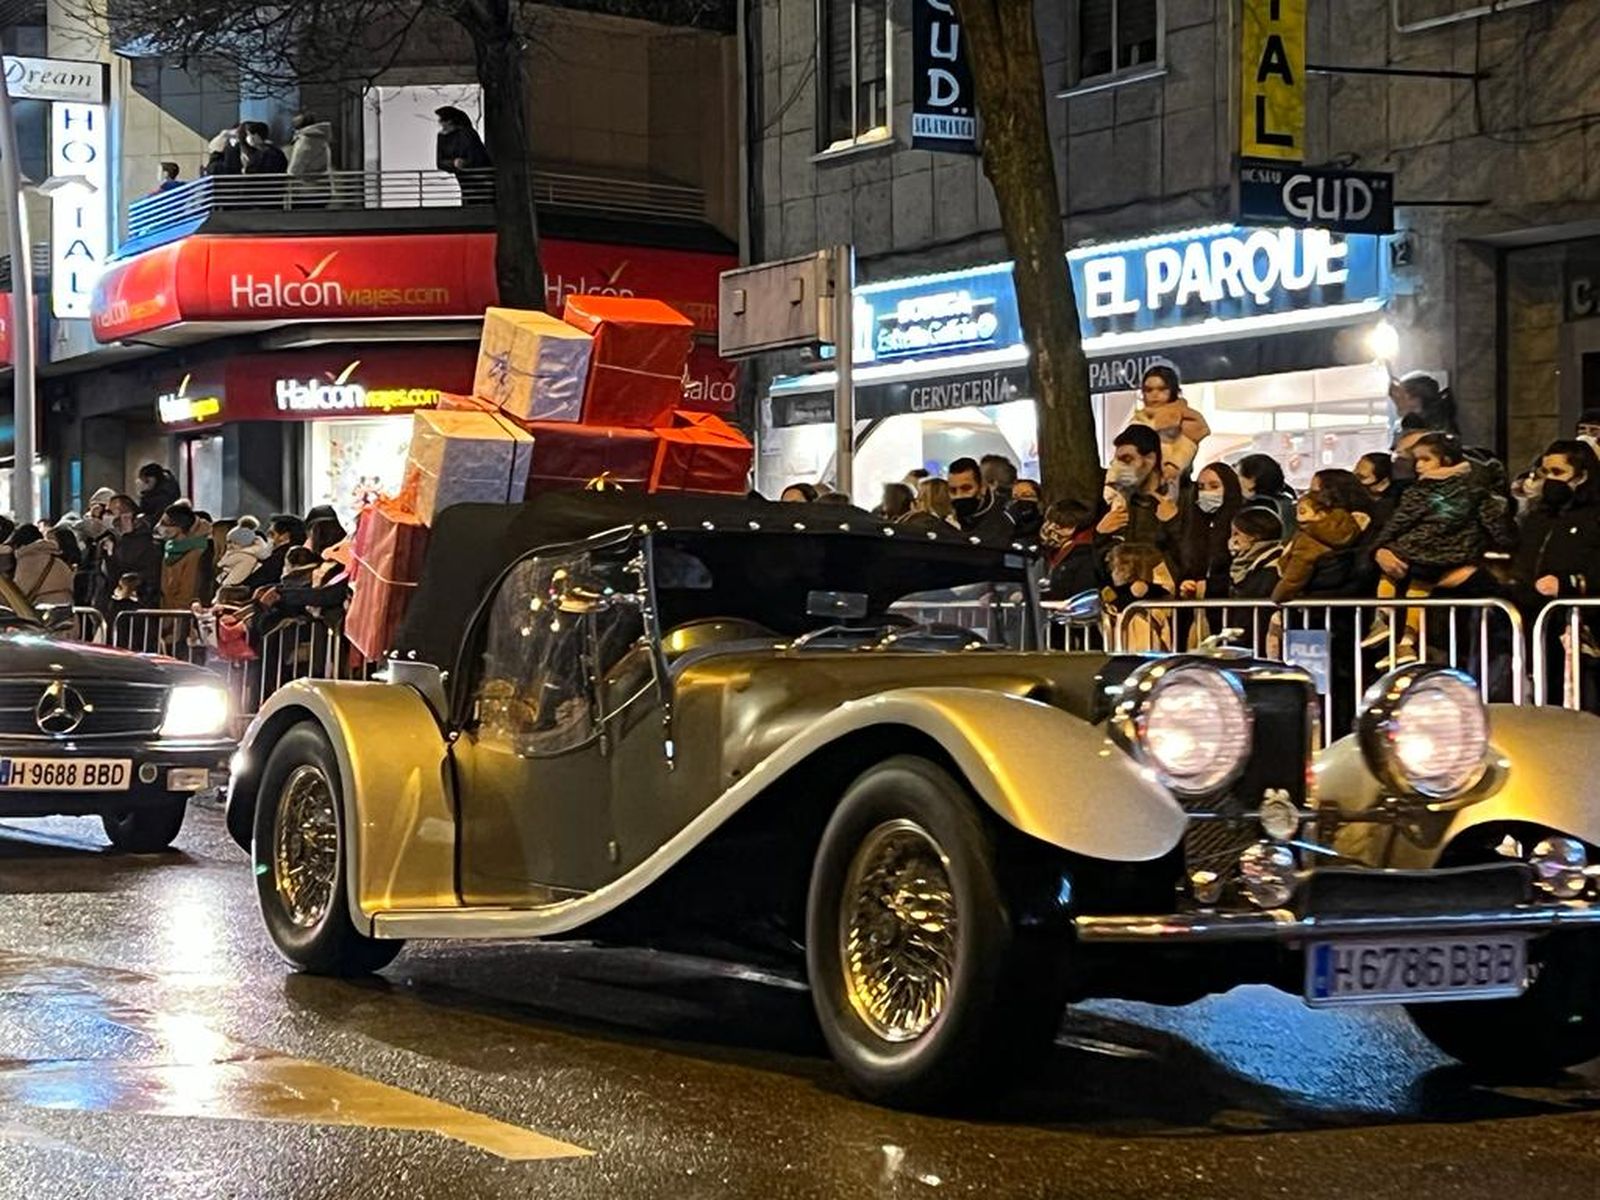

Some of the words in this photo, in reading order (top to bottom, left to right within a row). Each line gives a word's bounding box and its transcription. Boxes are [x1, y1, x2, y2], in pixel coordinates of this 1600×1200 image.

[6, 59, 92, 87] Dream
[1282, 174, 1373, 222] GUD
[1084, 256, 1141, 318] EL
[1145, 227, 1349, 309] PARQUE
[1088, 355, 1164, 389] PARQU
[910, 373, 1010, 412] CERVECERÍA
[11, 764, 25, 785] H
[31, 762, 77, 786] 9688
[83, 763, 125, 785] BBD
[1360, 947, 1444, 990] 6786
